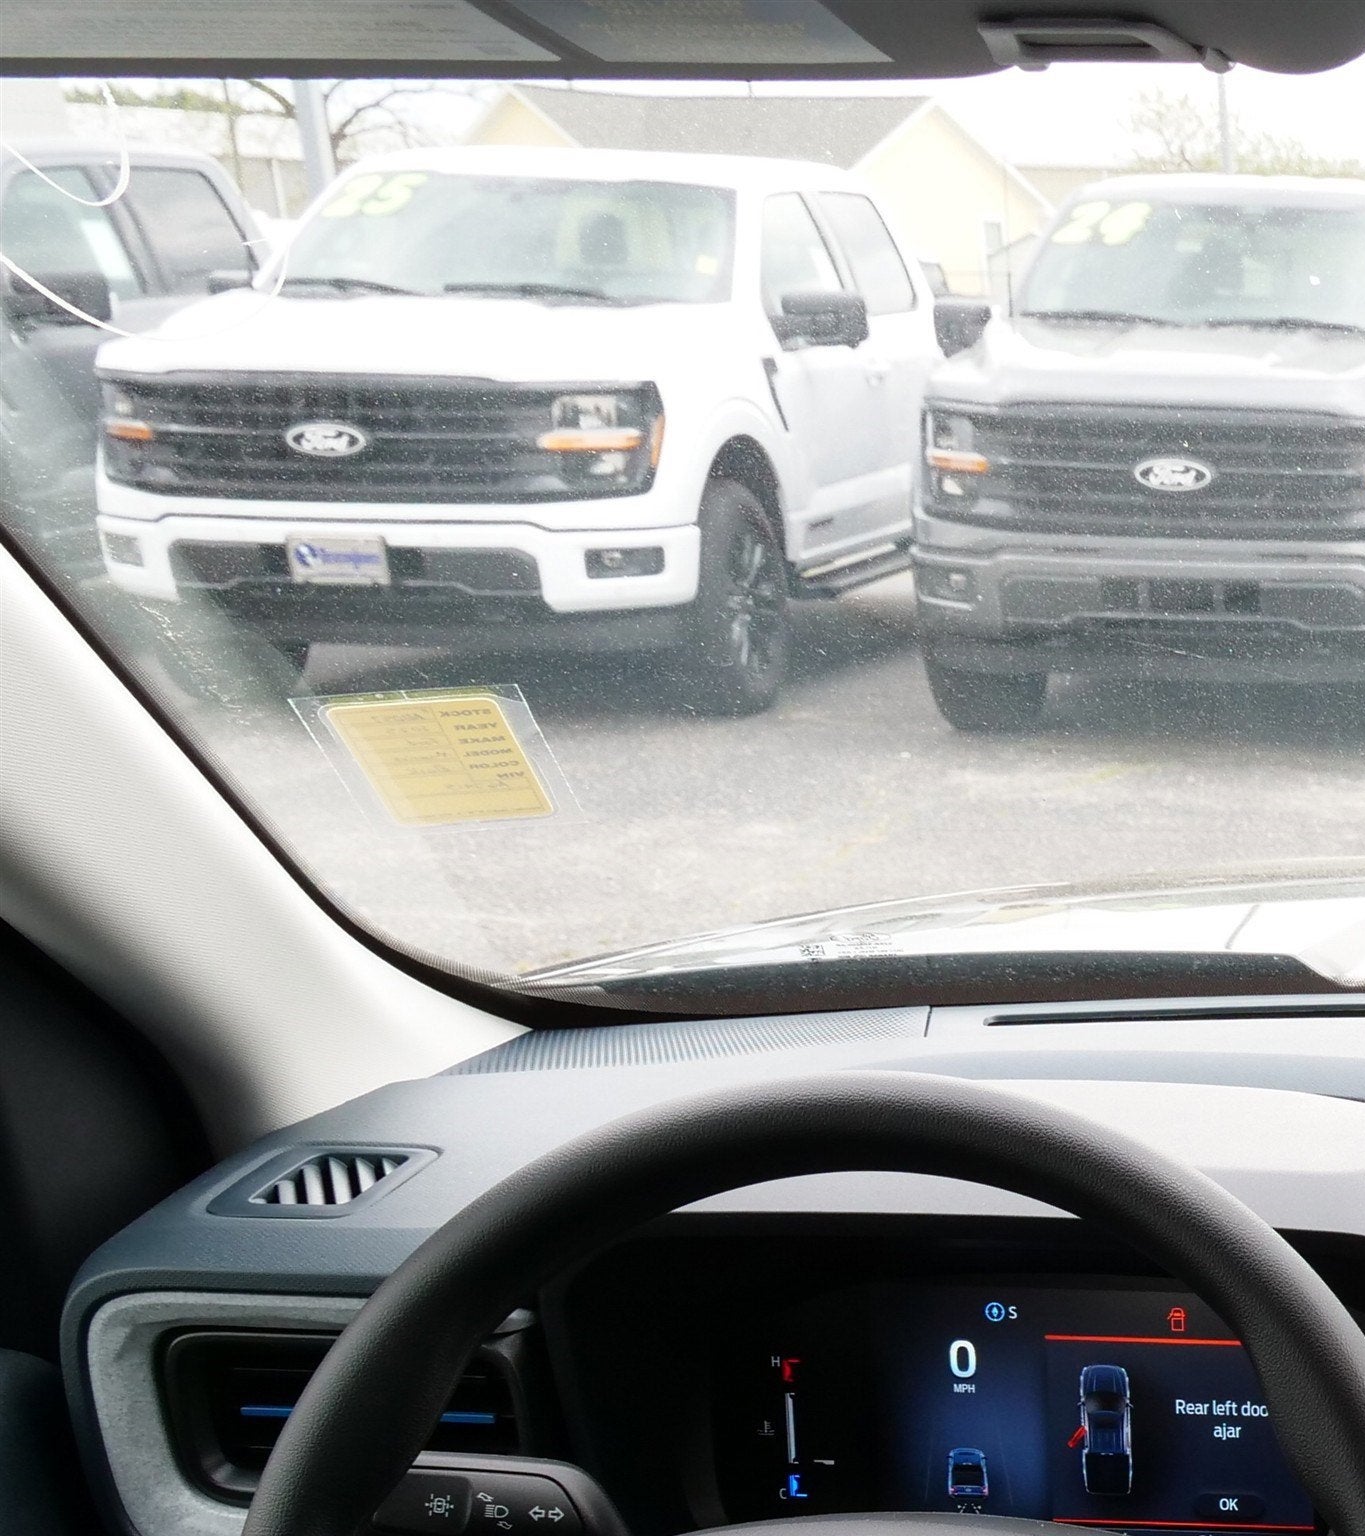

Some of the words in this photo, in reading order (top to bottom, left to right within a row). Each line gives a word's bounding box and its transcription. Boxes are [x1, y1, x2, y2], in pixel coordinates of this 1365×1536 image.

[1008, 1306, 1018, 1319] S
[771, 1356, 780, 1367] H
[949, 1339, 977, 1378] 0
[953, 1383, 976, 1394] MPH
[1175, 1399, 1210, 1416] Rear
[1212, 1400, 1238, 1416] left
[1241, 1401, 1269, 1417] doo
[1213, 1423, 1241, 1440] ajar
[779, 1488, 787, 1499] C
[1219, 1499, 1238, 1512] OK
